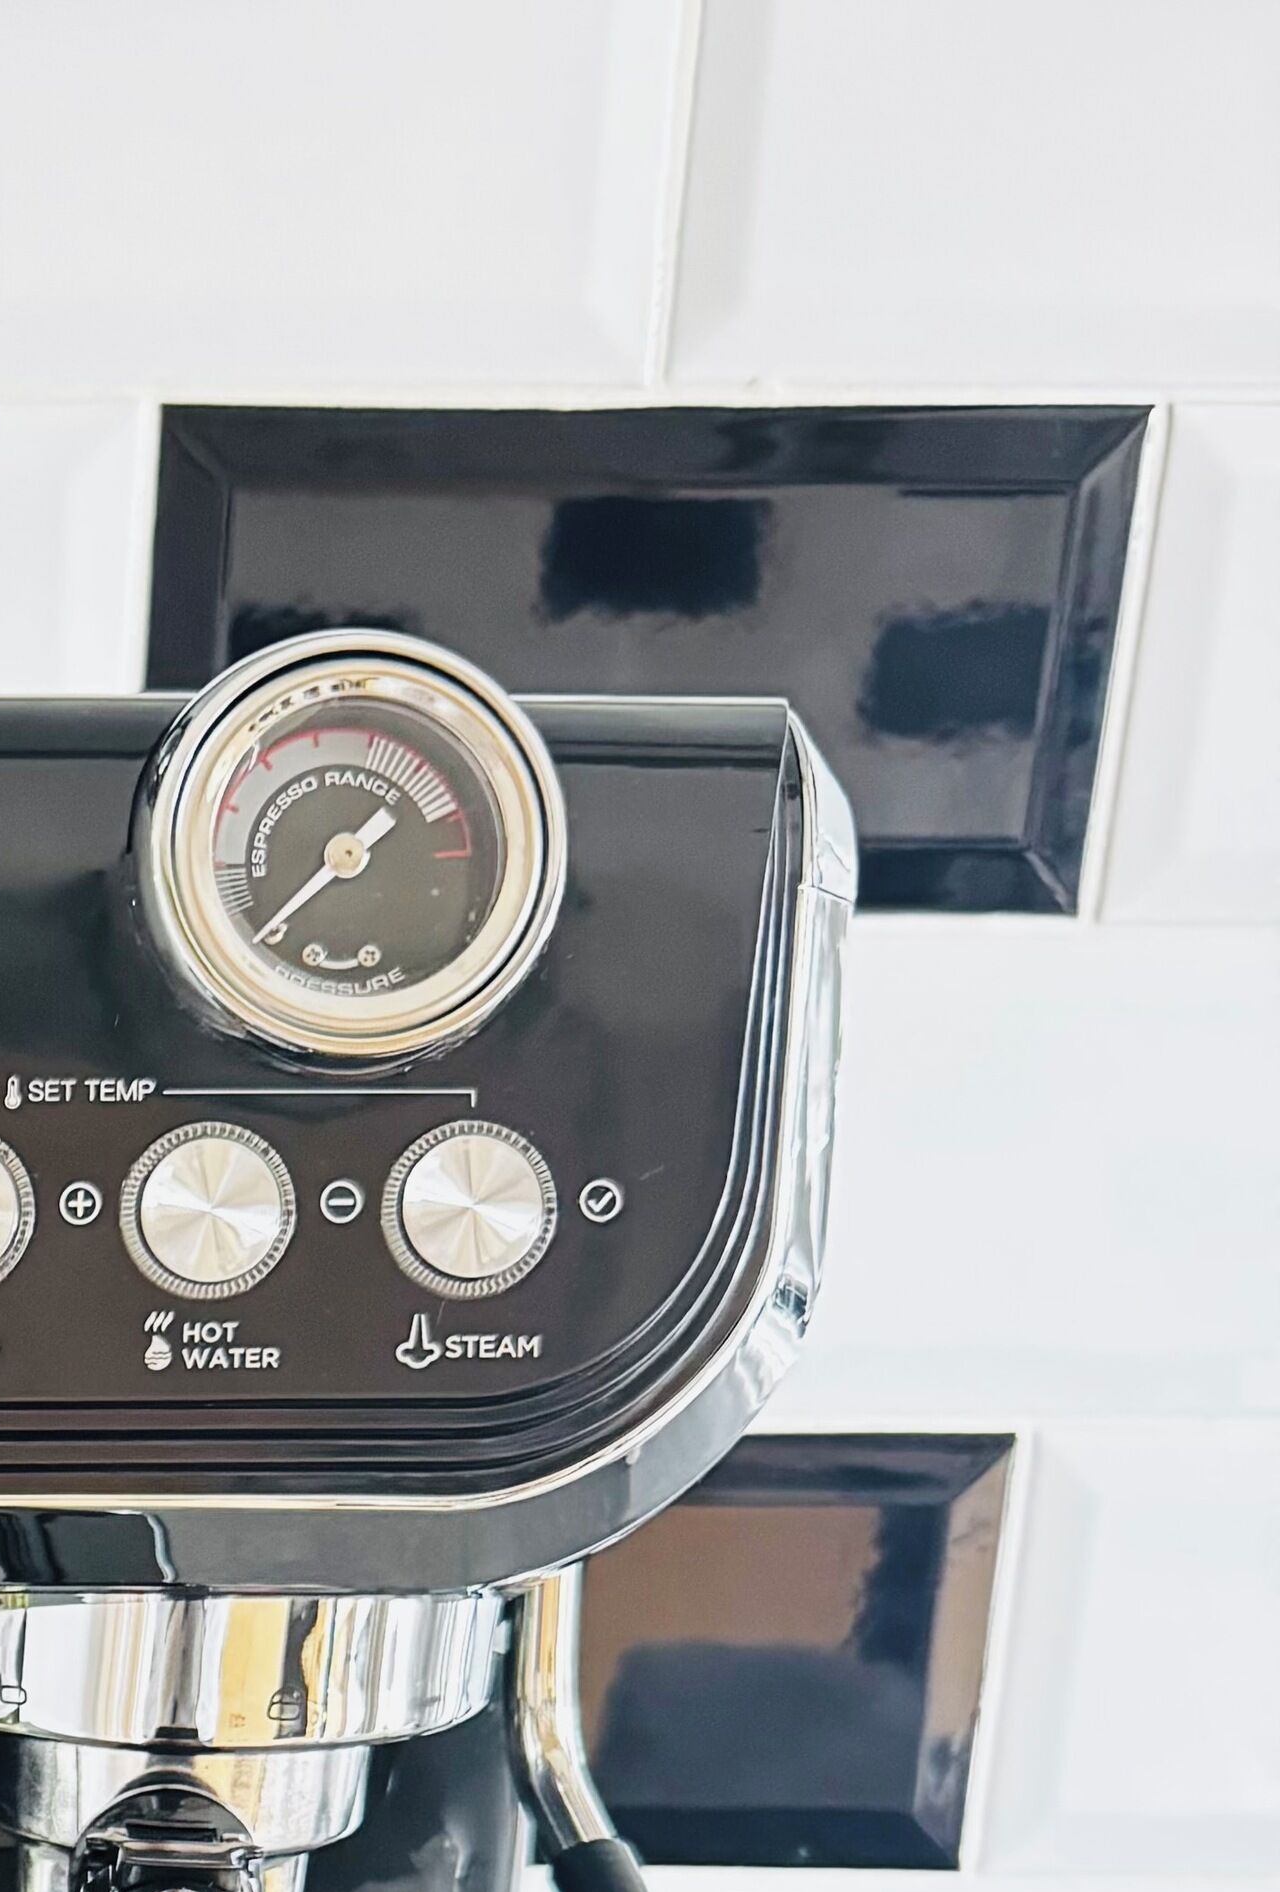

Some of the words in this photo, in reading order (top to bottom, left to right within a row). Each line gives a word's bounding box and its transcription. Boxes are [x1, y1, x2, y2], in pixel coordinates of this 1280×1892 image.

[251, 776, 318, 878] ESPRESSO
[324, 771, 402, 806] RANGE
[27, 1078, 77, 1103] SET
[84, 1078, 157, 1103] TEMP
[182, 1321, 240, 1344] HOT
[181, 1347, 282, 1370] WATER
[444, 1334, 542, 1359] STEAM
